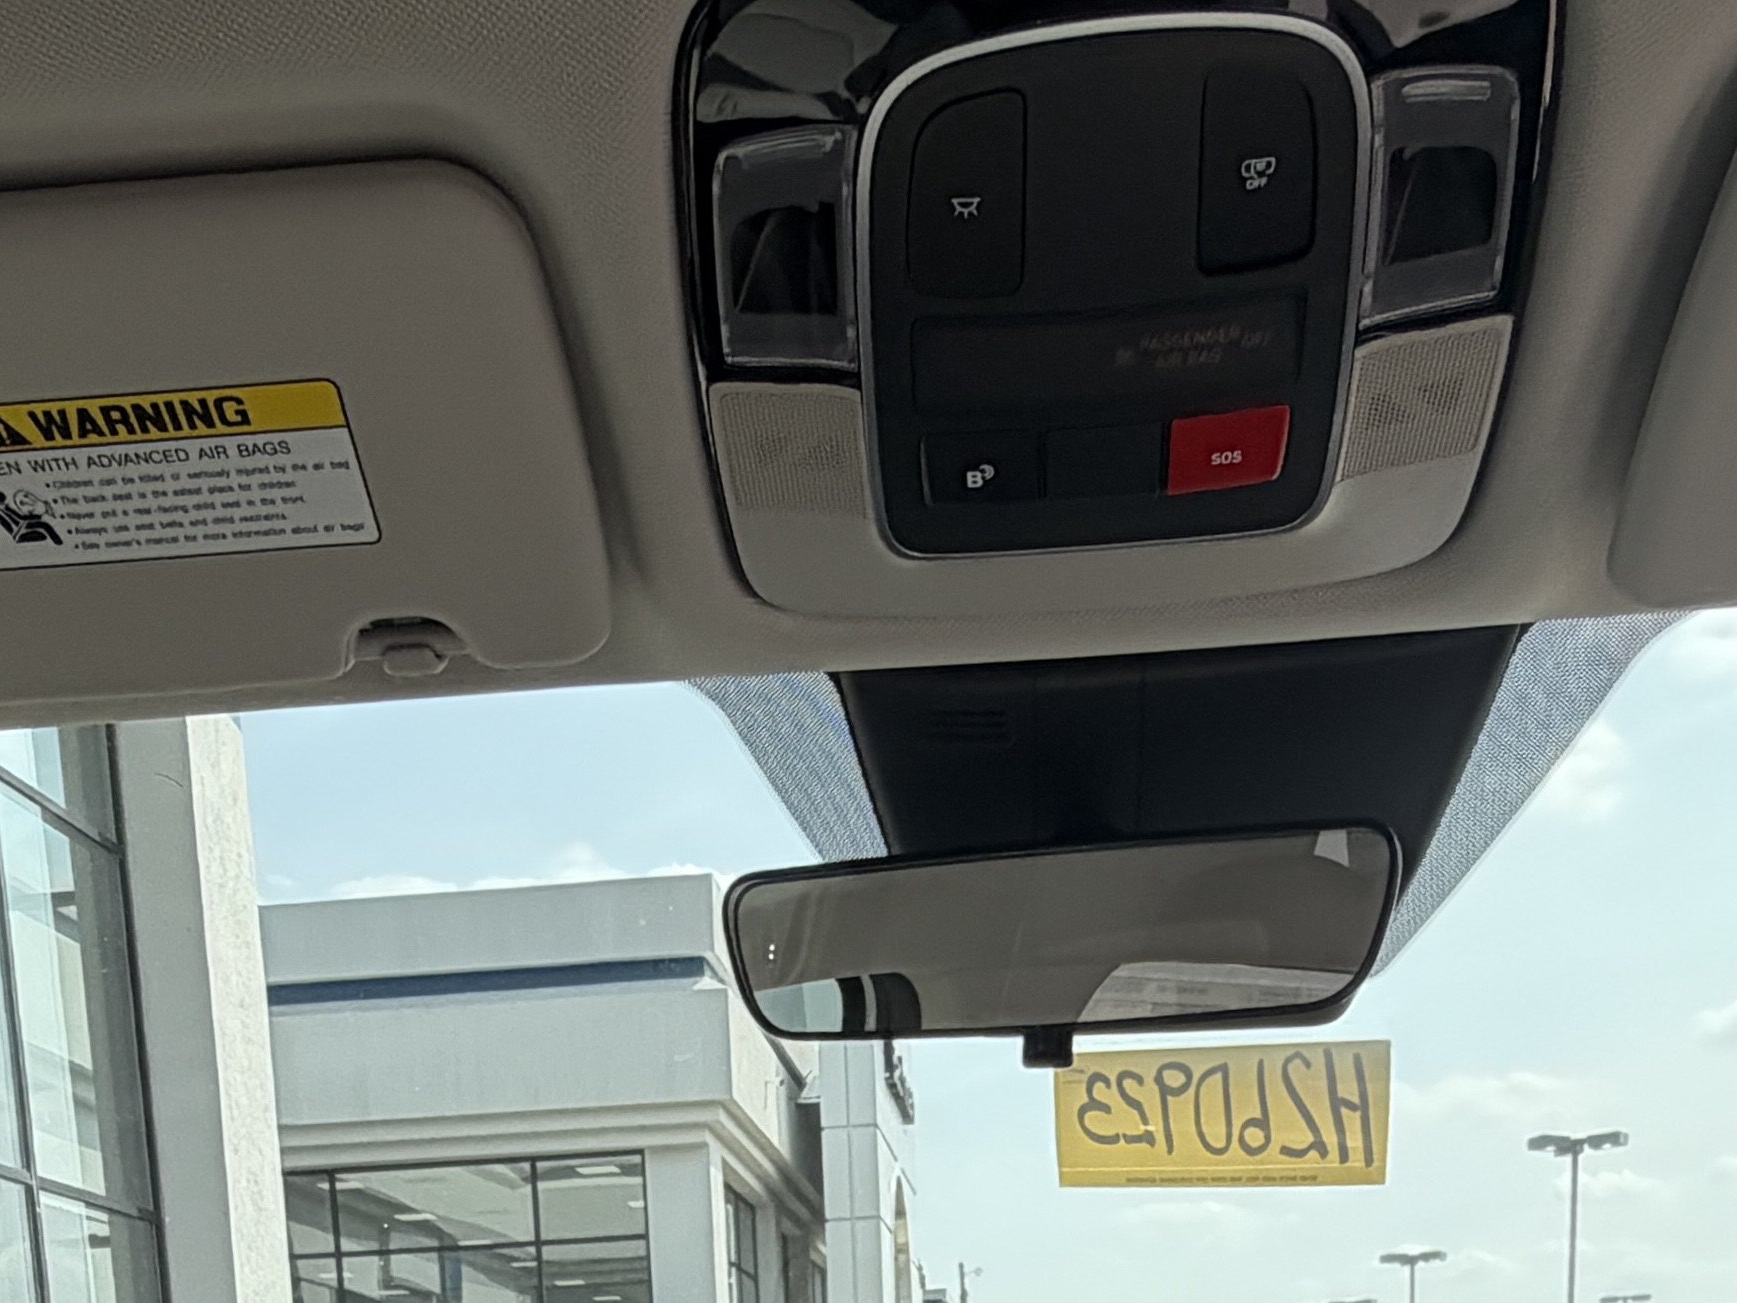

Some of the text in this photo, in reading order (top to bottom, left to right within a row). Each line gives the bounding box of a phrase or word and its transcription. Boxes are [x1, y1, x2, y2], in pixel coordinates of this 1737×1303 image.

[27, 395, 251, 442] WARNING
[27, 456, 78, 474] WITH
[86, 447, 190, 469] ADVANCED
[197, 443, 234, 461] AIR
[237, 440, 292, 458] BAGS
[1211, 450, 1242, 465] SOS
